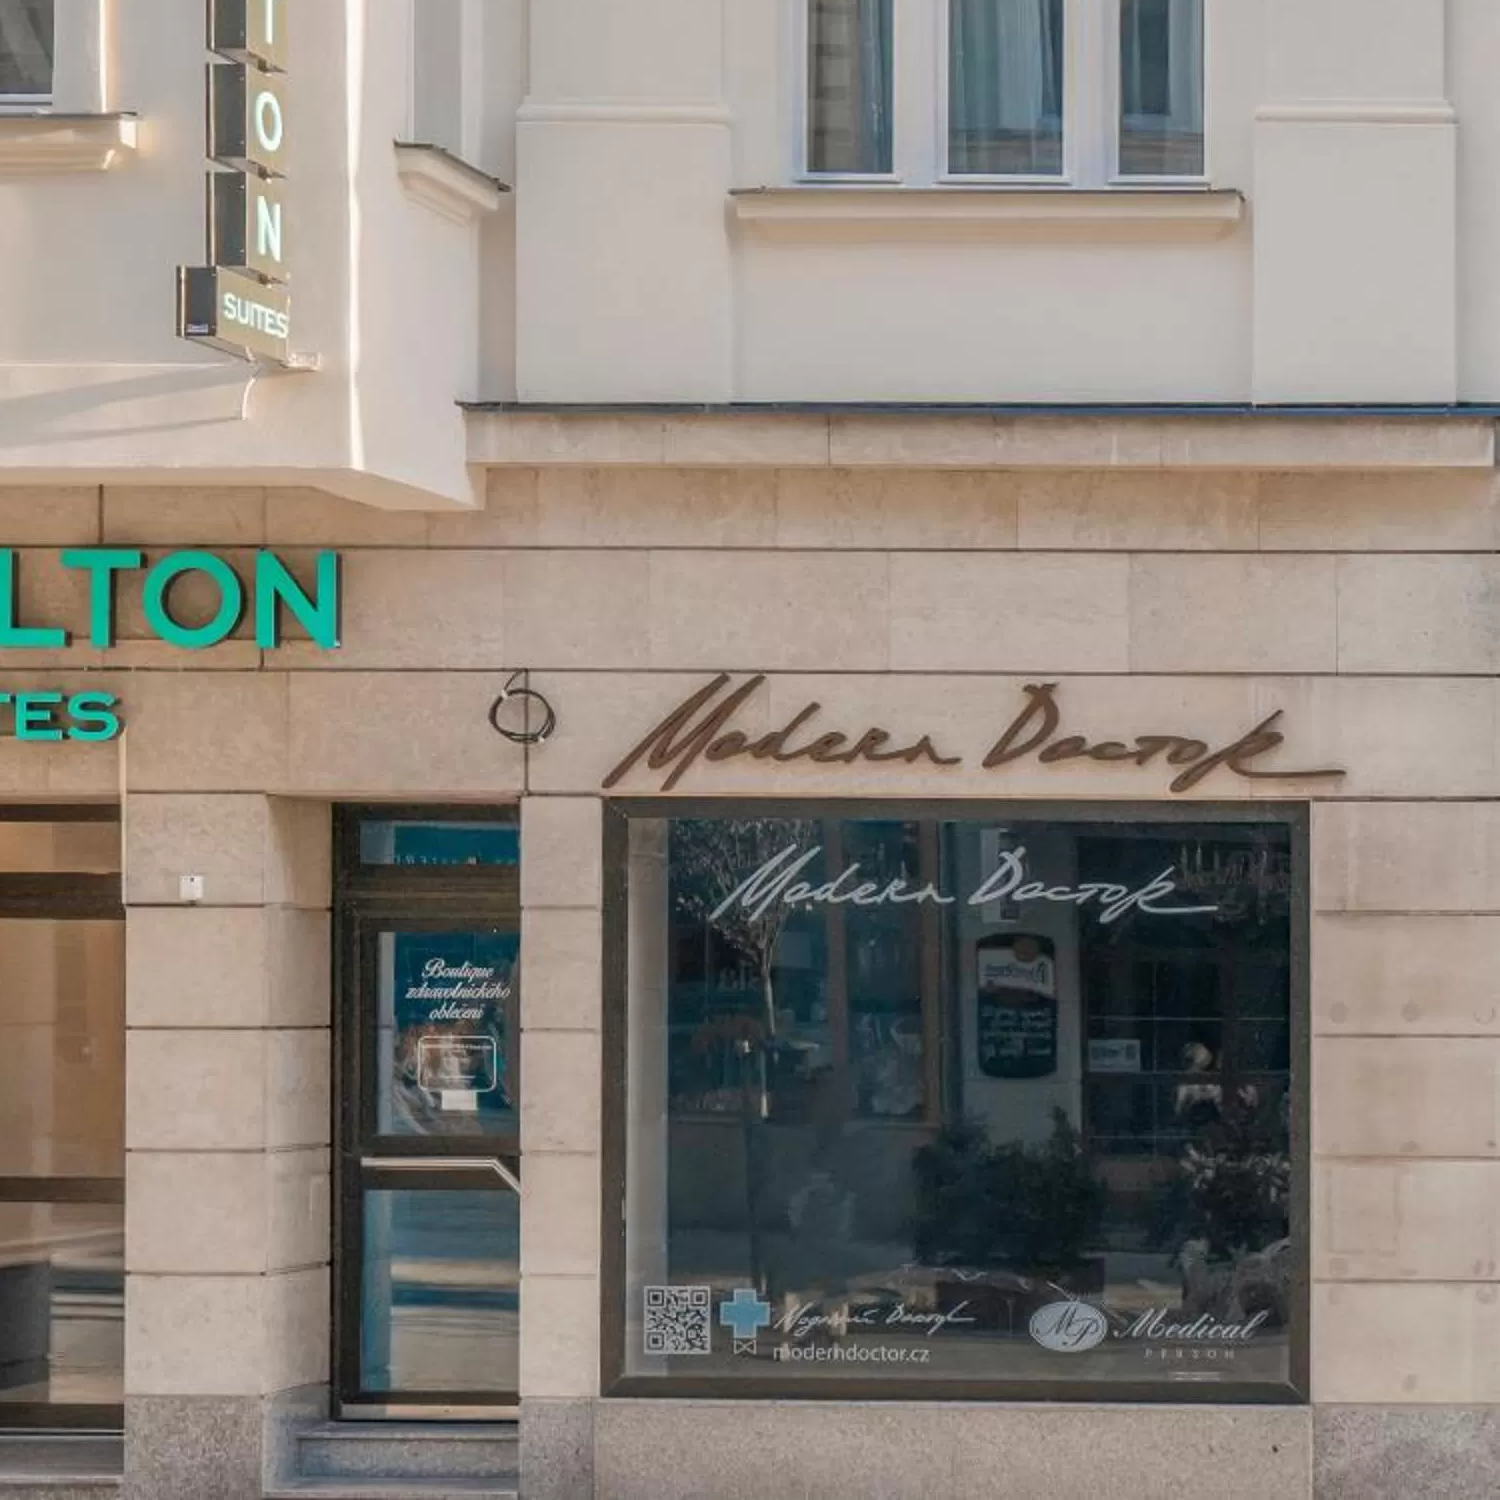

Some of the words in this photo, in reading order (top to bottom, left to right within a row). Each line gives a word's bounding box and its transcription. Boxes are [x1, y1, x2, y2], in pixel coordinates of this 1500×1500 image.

[222, 291, 289, 340] SUITES
[421, 957, 495, 982] Boutique
[428, 1001, 486, 1021] oblečení
[1112, 1307, 1270, 1340] Medical
[772, 1343, 932, 1364] moderndoctor.cz
[1143, 1348, 1236, 1360] PERSON
